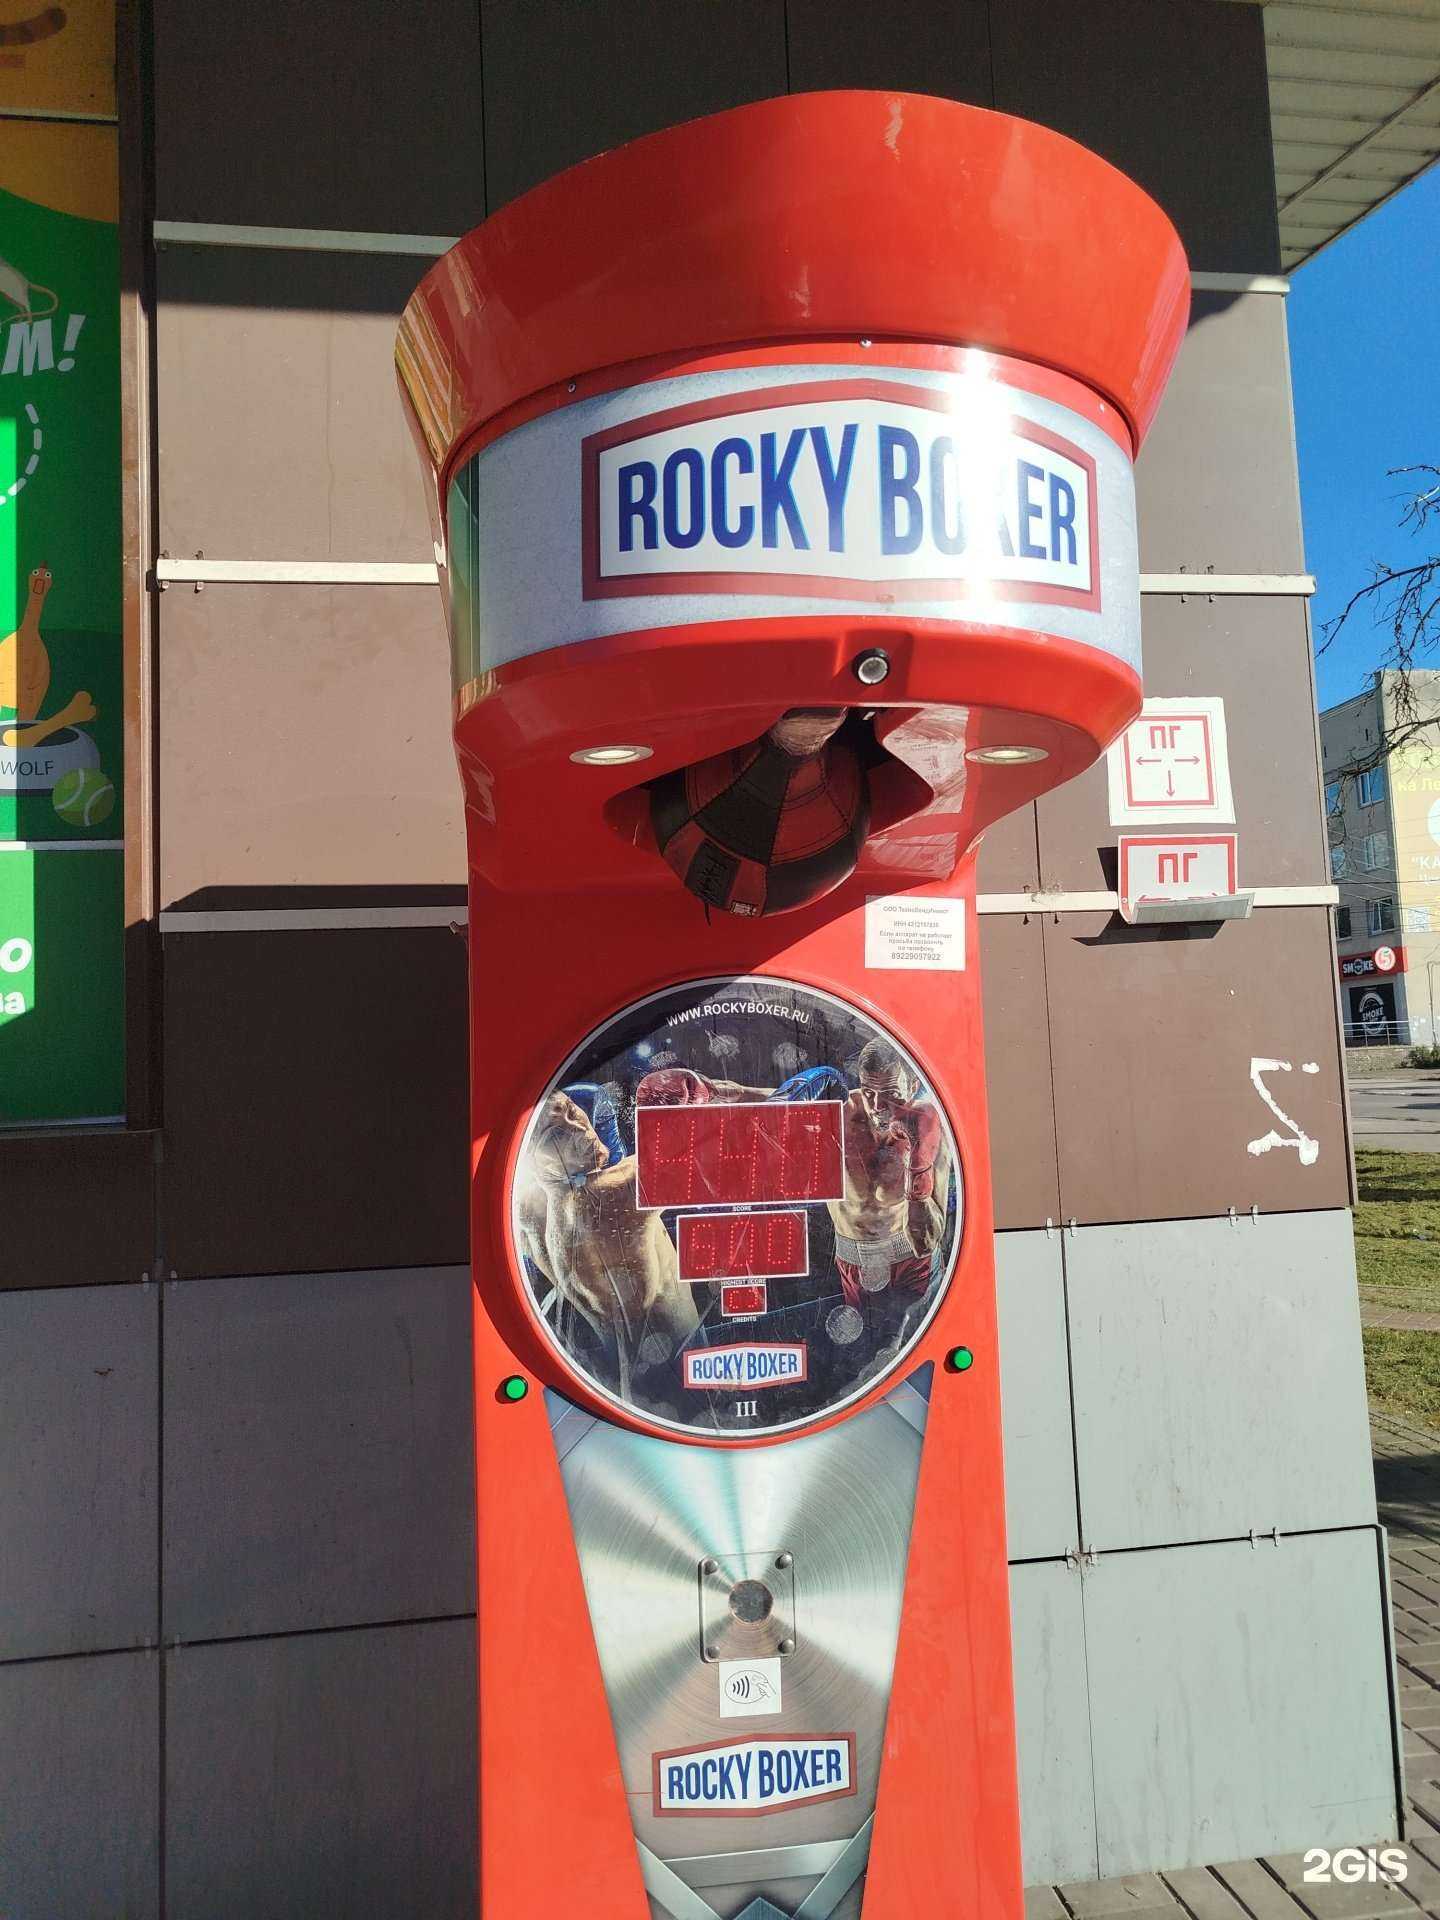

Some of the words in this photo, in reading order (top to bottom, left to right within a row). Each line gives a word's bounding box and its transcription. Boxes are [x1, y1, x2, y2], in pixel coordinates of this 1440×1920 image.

[618, 423, 859, 553] ROCKY
[878, 424, 1078, 566] BOER
[1149, 725, 1181, 749] ПГ
[1158, 852, 1198, 884] ПГ
[666, 1001, 810, 1027] WWW.ROCKYBOXER.RU
[691, 1218, 793, 1270] 500
[692, 1353, 743, 1380] ROCKY
[747, 1352, 798, 1380] BOXER
[735, 1400, 758, 1417] III
[667, 1751, 753, 1800] ROCKY
[758, 1749, 842, 1799] BOXER
